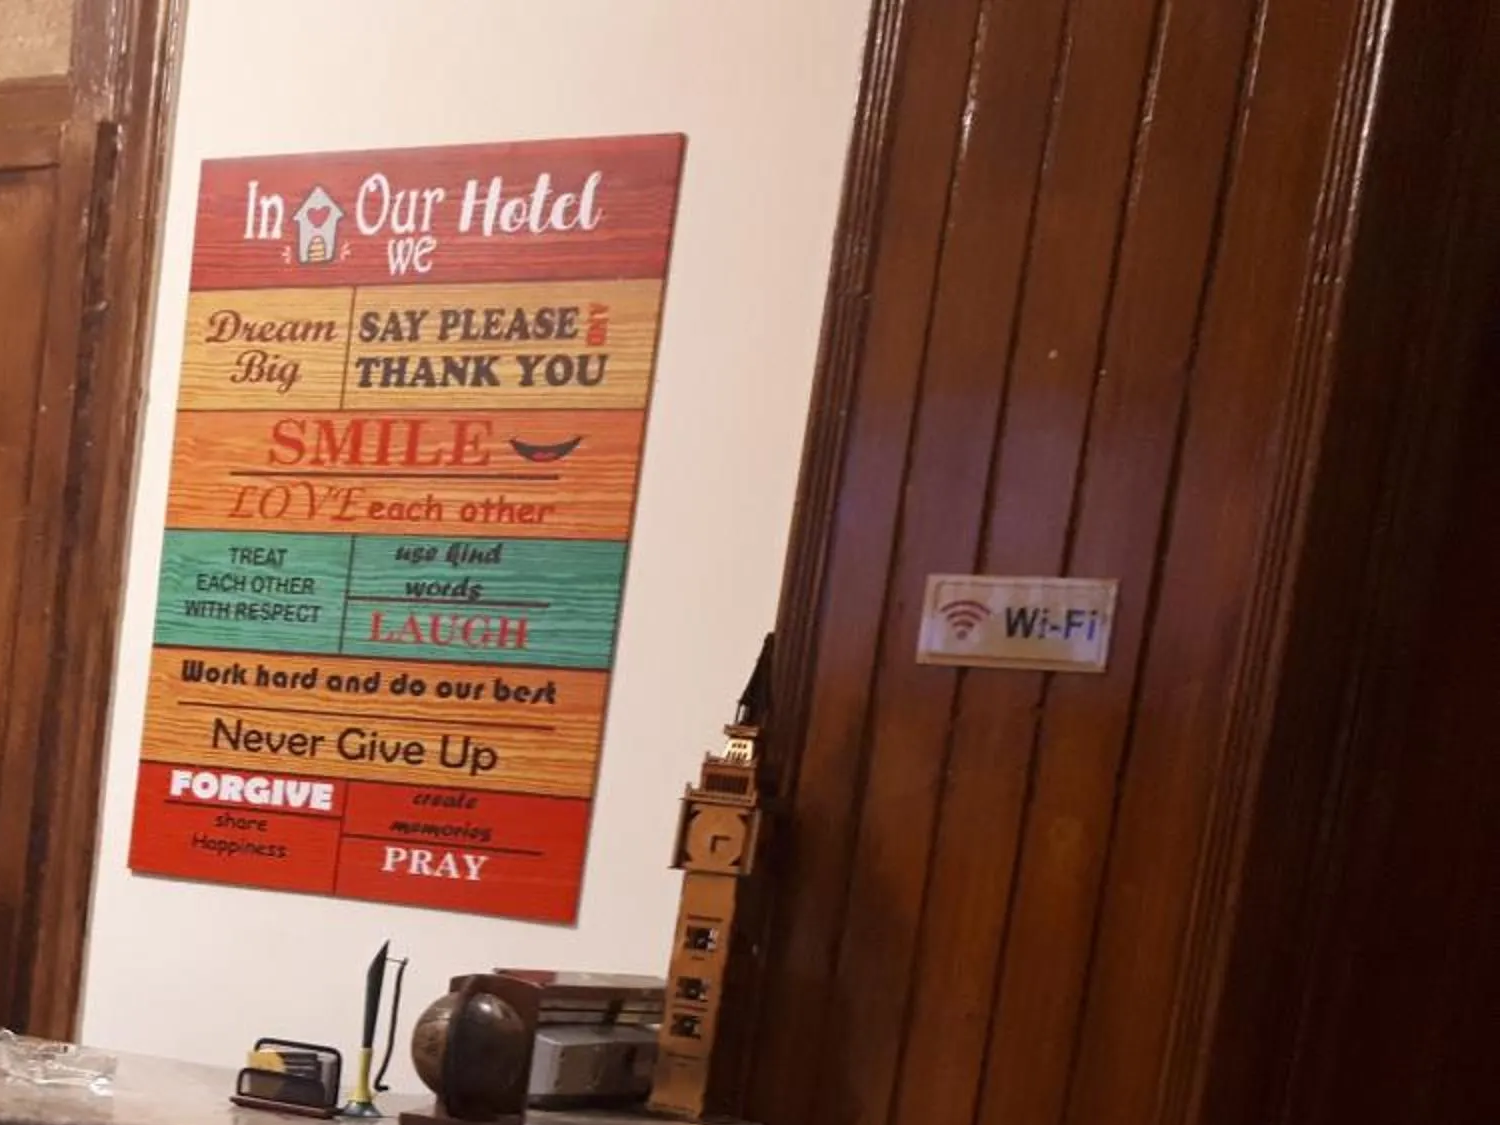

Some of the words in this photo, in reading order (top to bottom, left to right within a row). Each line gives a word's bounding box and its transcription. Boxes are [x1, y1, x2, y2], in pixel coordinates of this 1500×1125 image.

[244, 180, 283, 240] In
[355, 172, 446, 236] Our
[458, 171, 602, 237] Hotel
[387, 235, 436, 276] we
[205, 309, 338, 345] Dream
[357, 309, 428, 343] SAY
[437, 306, 581, 343] PLEASE
[230, 348, 300, 394] Big
[356, 355, 502, 389] THANK
[516, 353, 609, 387] YOU
[268, 417, 494, 468] SMILE
[228, 481, 366, 522] LOVE
[368, 495, 444, 524] each
[459, 496, 555, 525] other
[229, 547, 288, 567] TREAT
[395, 546, 438, 564] use
[196, 573, 247, 593] EACH
[250, 575, 315, 596] OTHER
[405, 576, 484, 601] words
[185, 601, 231, 621] WITH
[234, 601, 320, 624] RESPECT
[369, 611, 529, 650] LAUGH
[1005, 607, 1099, 641] Wi-Fi
[181, 659, 248, 687] Work
[255, 664, 318, 690] hard
[326, 668, 381, 694] and
[390, 672, 426, 697] do
[440, 679, 484, 701] our
[493, 677, 557, 704] best
[212, 717, 325, 758] Never
[336, 727, 425, 767] Give
[439, 735, 498, 776] Up
[169, 770, 333, 811] FORGIVE
[412, 791, 478, 811] create
[214, 813, 269, 833] share
[389, 820, 492, 843] memories
[192, 833, 289, 861] Happiness
[382, 847, 488, 881] PRAY
